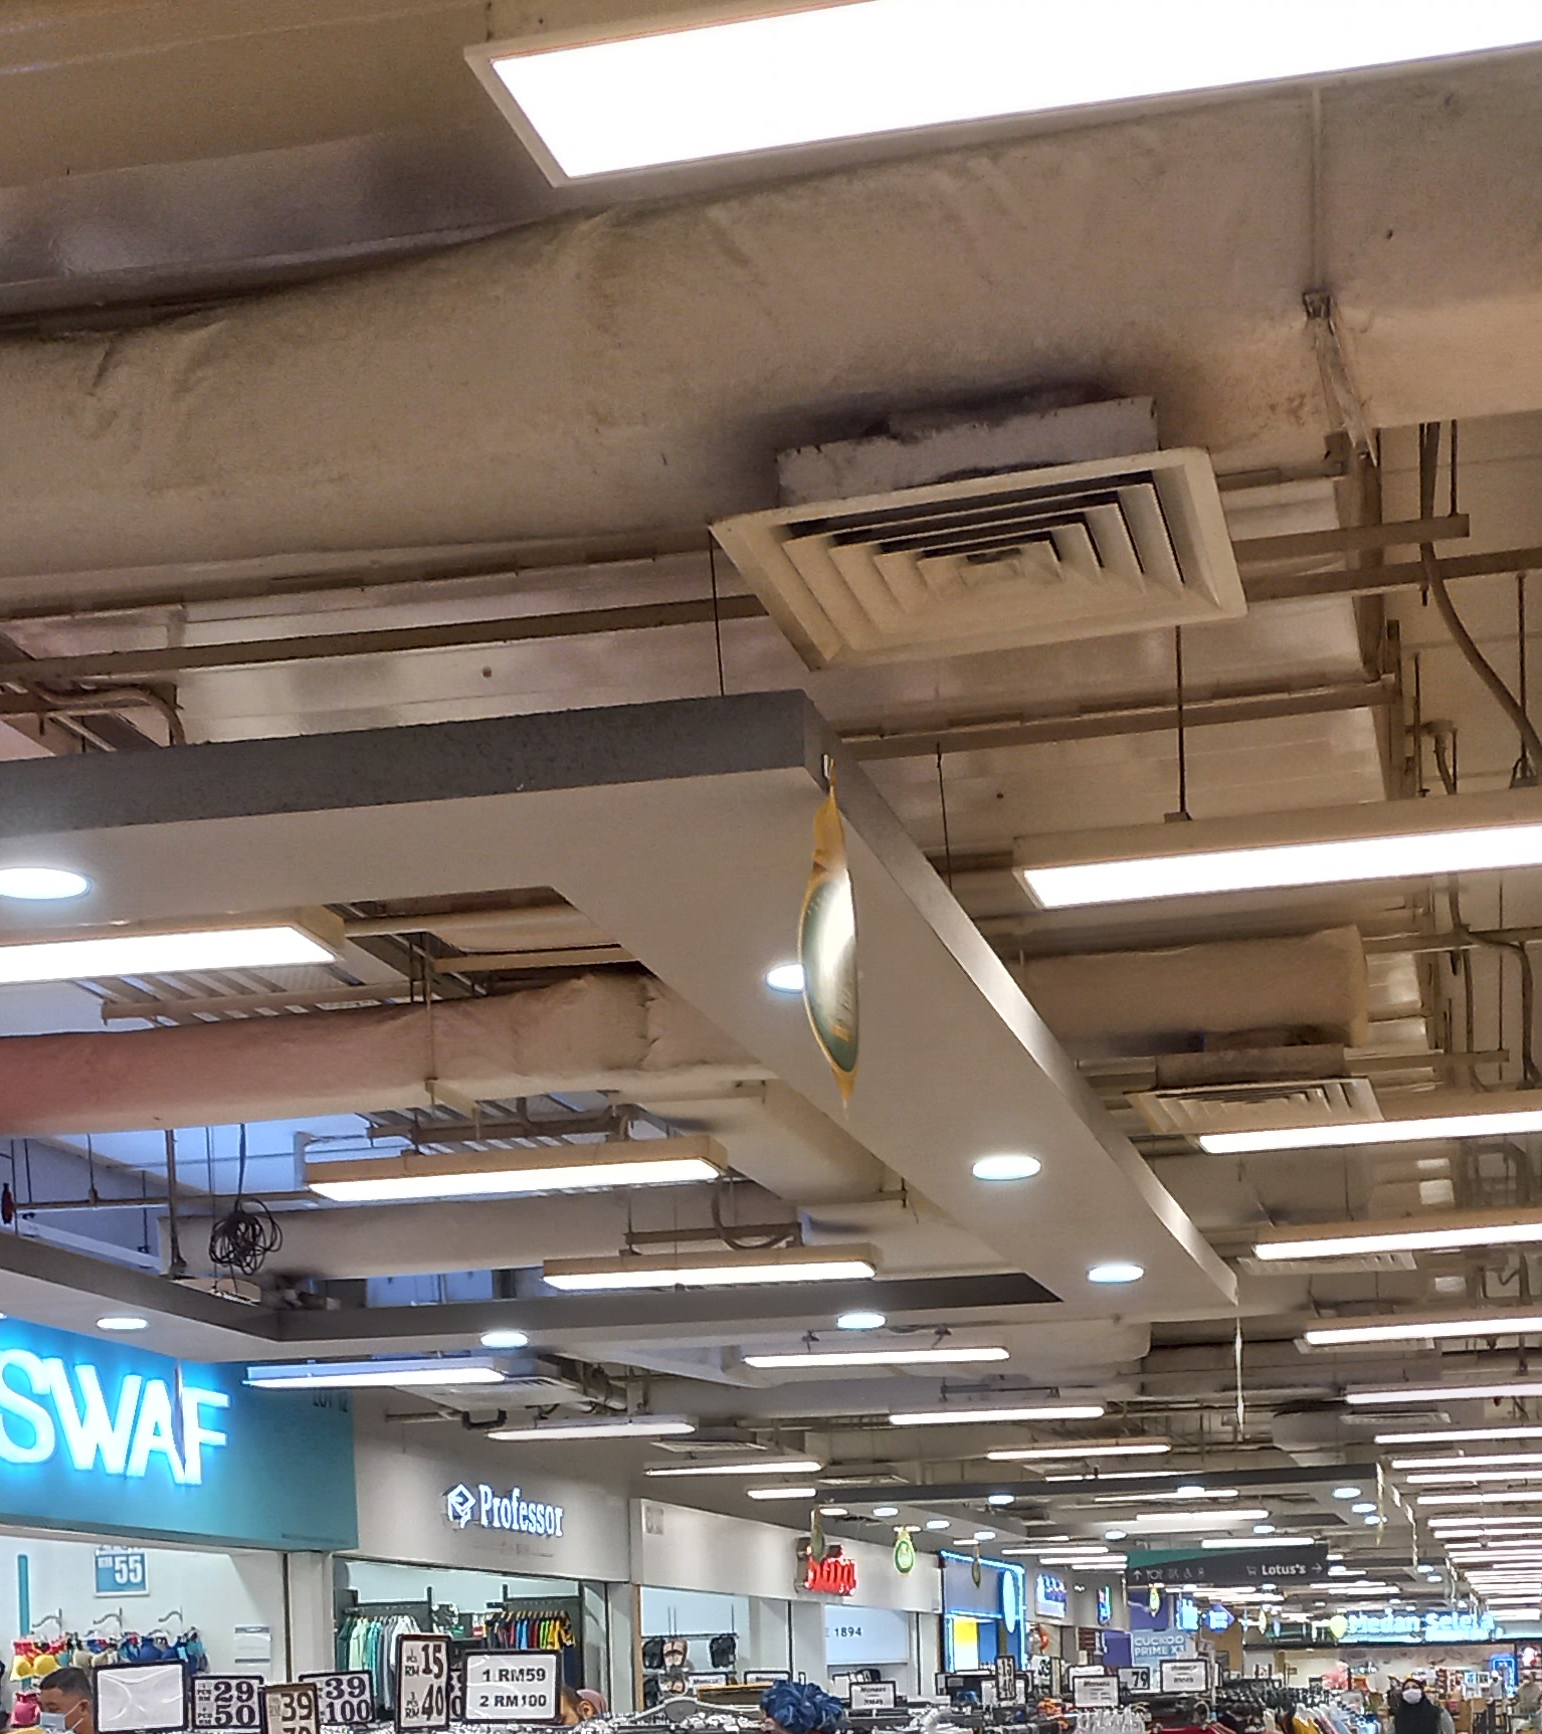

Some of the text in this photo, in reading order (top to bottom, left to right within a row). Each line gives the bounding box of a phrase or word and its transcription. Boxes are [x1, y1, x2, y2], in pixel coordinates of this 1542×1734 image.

[478, 1483, 564, 1537] Professor
[114, 1555, 143, 1585] 55
[1261, 1563, 1307, 1576] Lotus's
[833, 1626, 863, 1638] 1894
[1133, 1635, 1185, 1646] CUCKOO
[421, 1644, 444, 1680] 15
[1133, 1645, 1168, 1657] PRIME
[482, 1668, 547, 1682] 1 RM59
[1131, 1671, 1148, 1688] 79
[214, 1681, 255, 1703] 29
[325, 1676, 367, 1700] 39
[280, 1692, 313, 1722] 39
[326, 1700, 371, 1723] 100
[421, 1683, 444, 1721] 40
[479, 1695, 489, 1707] 2
[214, 1704, 256, 1726] 50
